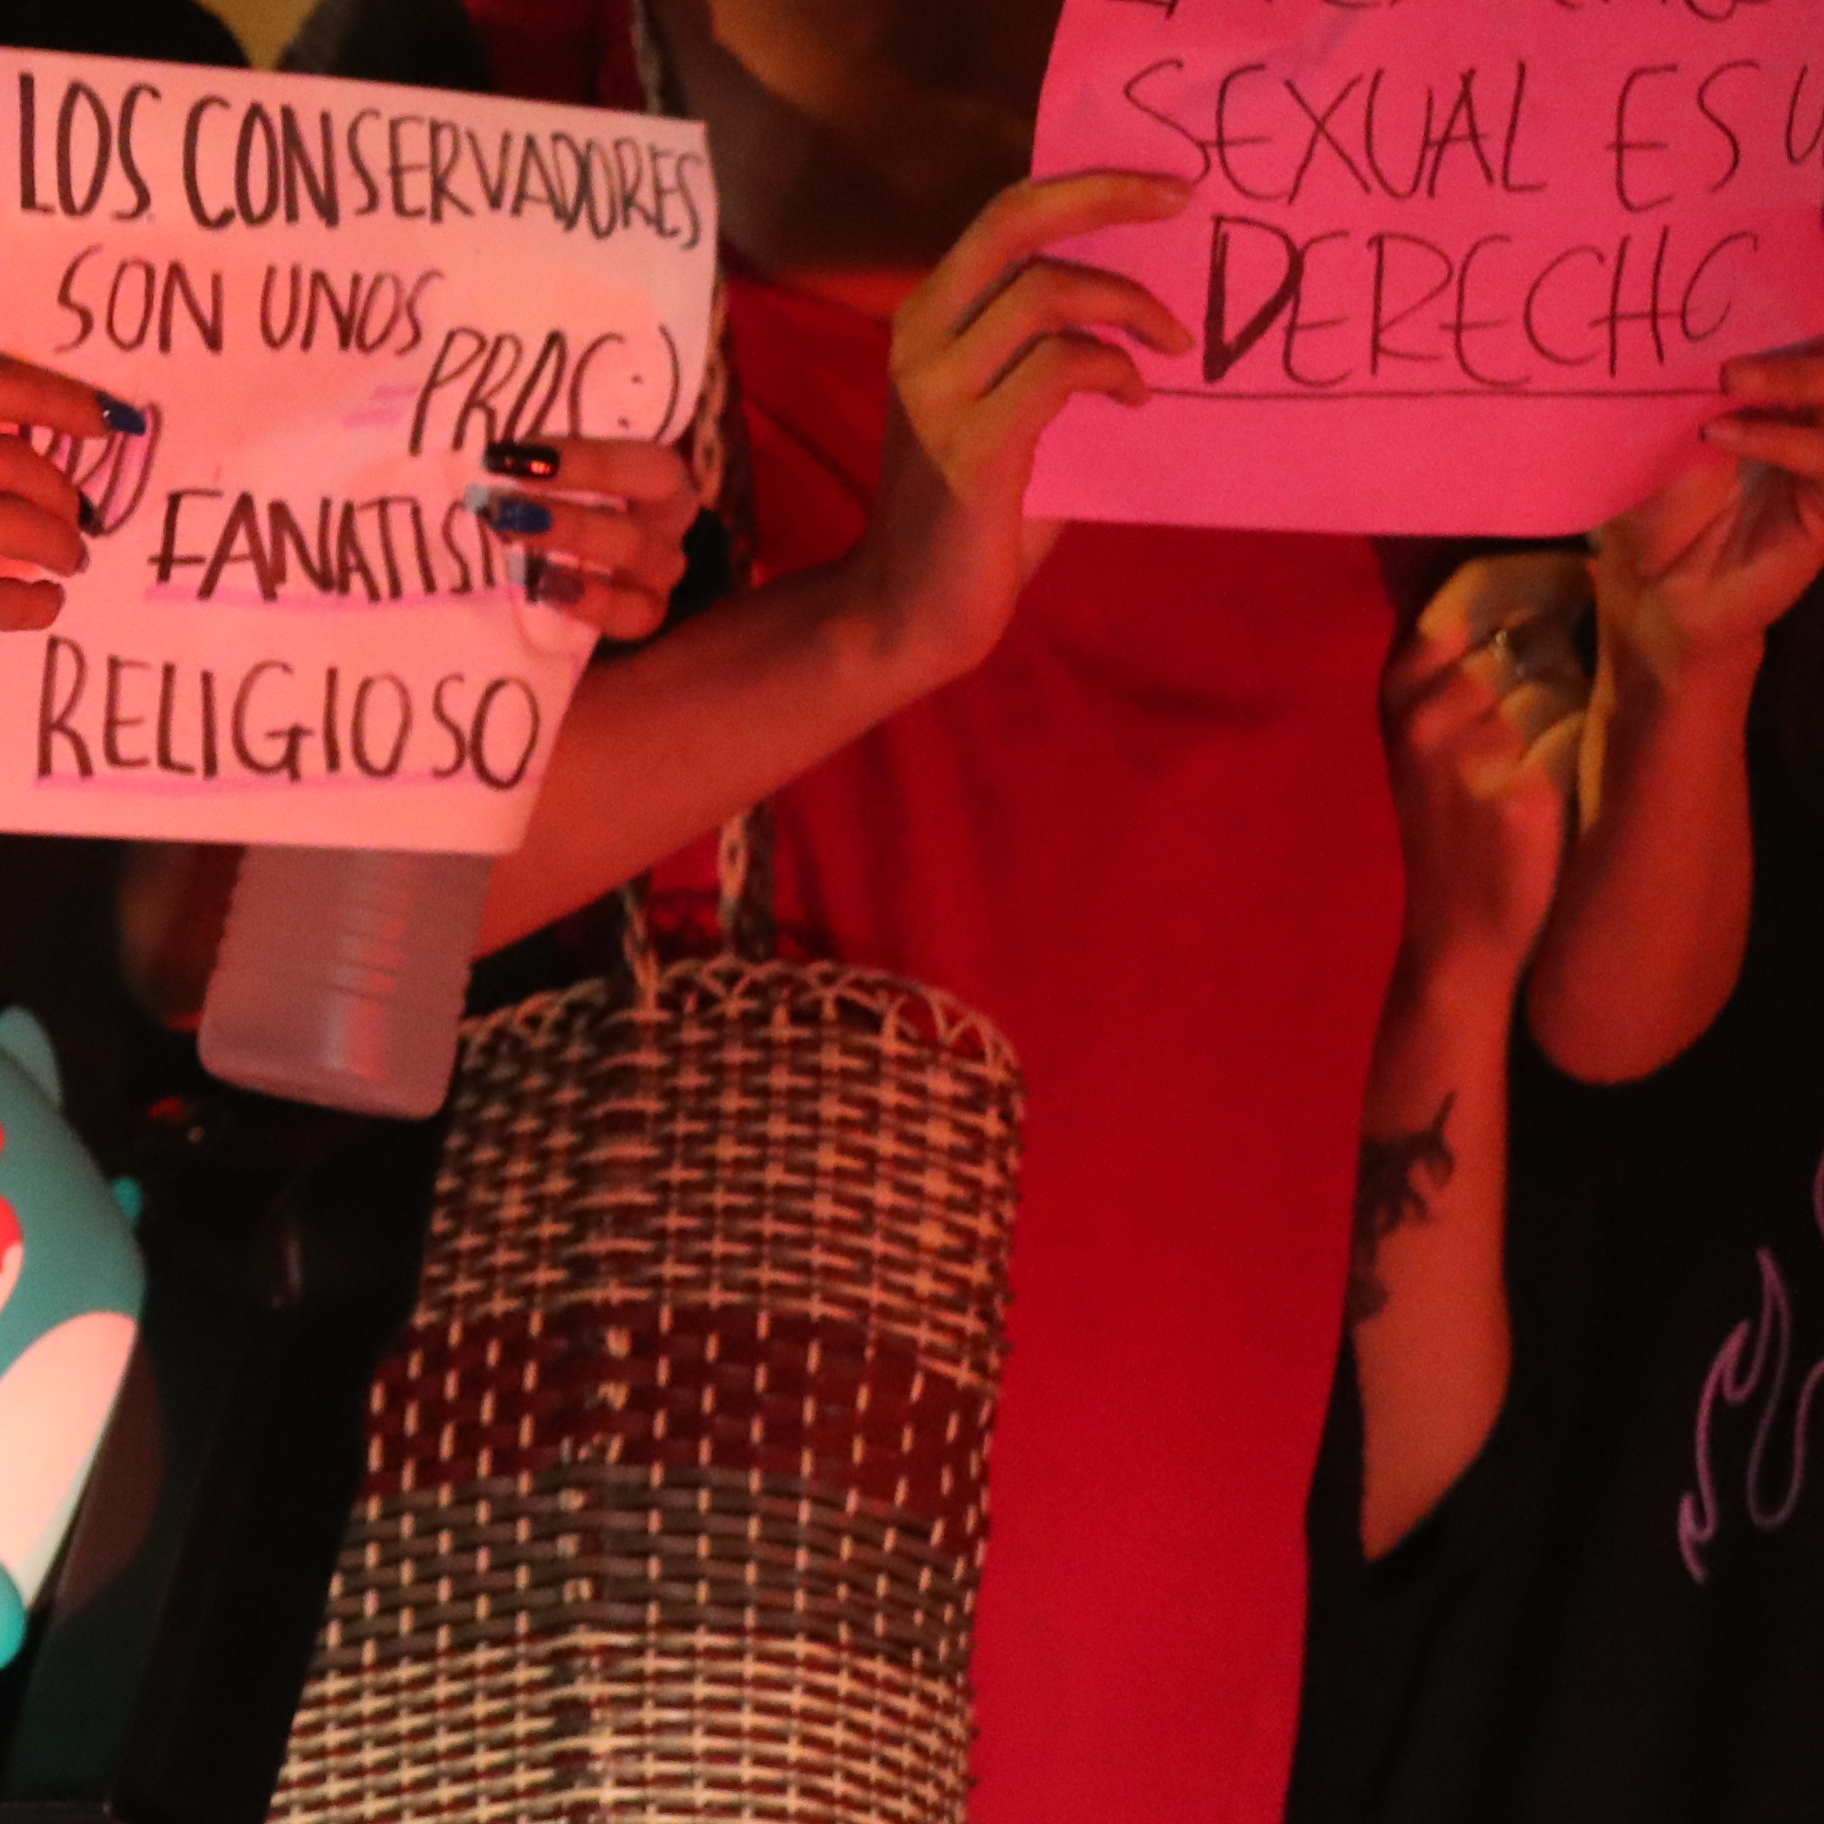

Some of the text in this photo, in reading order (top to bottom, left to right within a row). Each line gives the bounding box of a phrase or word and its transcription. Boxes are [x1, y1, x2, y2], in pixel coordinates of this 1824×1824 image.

[17, 71, 704, 251] LOS CONSERVADORES
[1124, 59, 1550, 205] SEXUAL
[1606, 60, 1761, 213] ES
[54, 243, 446, 358] SON UNOS
[36, 636, 539, 791] RELIGIOSO
